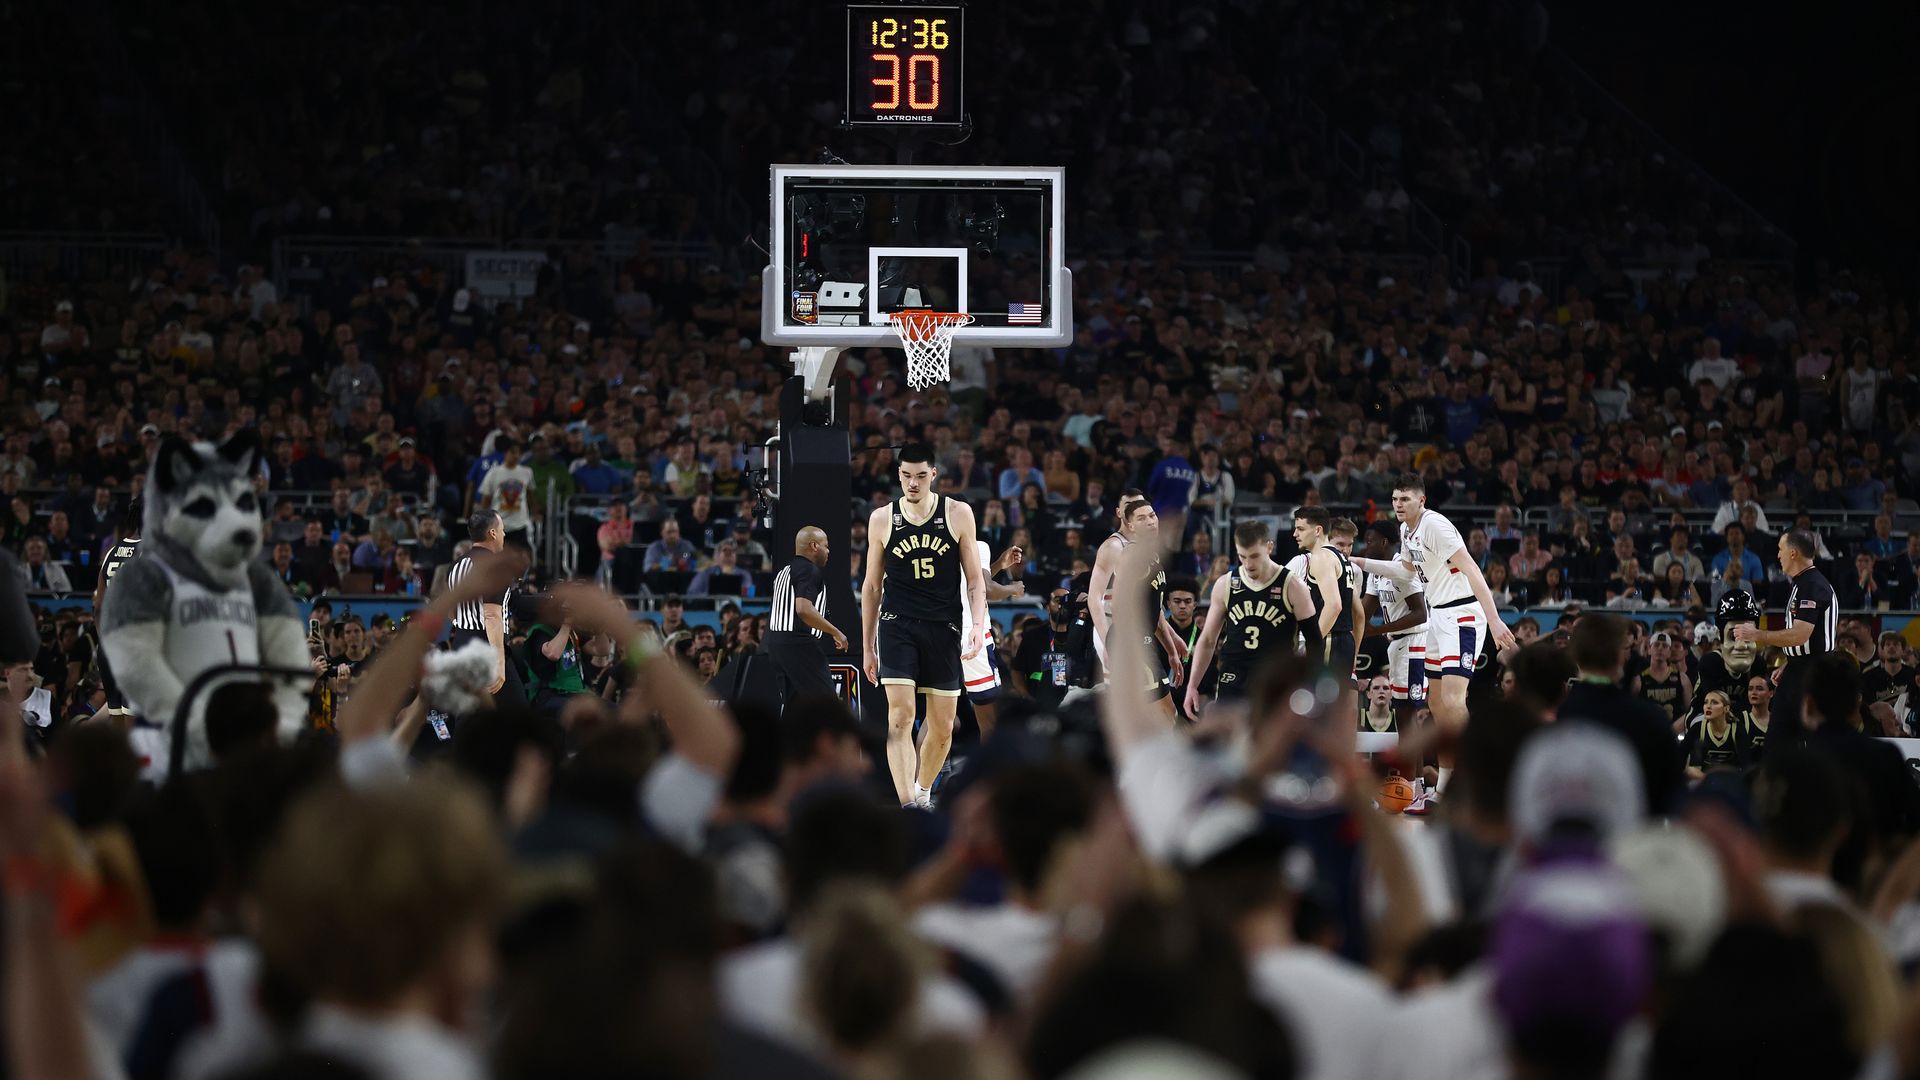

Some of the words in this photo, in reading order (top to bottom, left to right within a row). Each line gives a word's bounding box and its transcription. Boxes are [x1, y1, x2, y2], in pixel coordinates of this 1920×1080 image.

[872, 18, 949, 49] 12:36
[872, 54, 939, 110] 30
[475, 258, 540, 273] SECTIO
[114, 546, 135, 558] JONES
[892, 533, 951, 559] PURDUE
[911, 557, 935, 579] 15
[1228, 600, 1287, 628] PURDUE
[1243, 625, 1260, 650] 3
